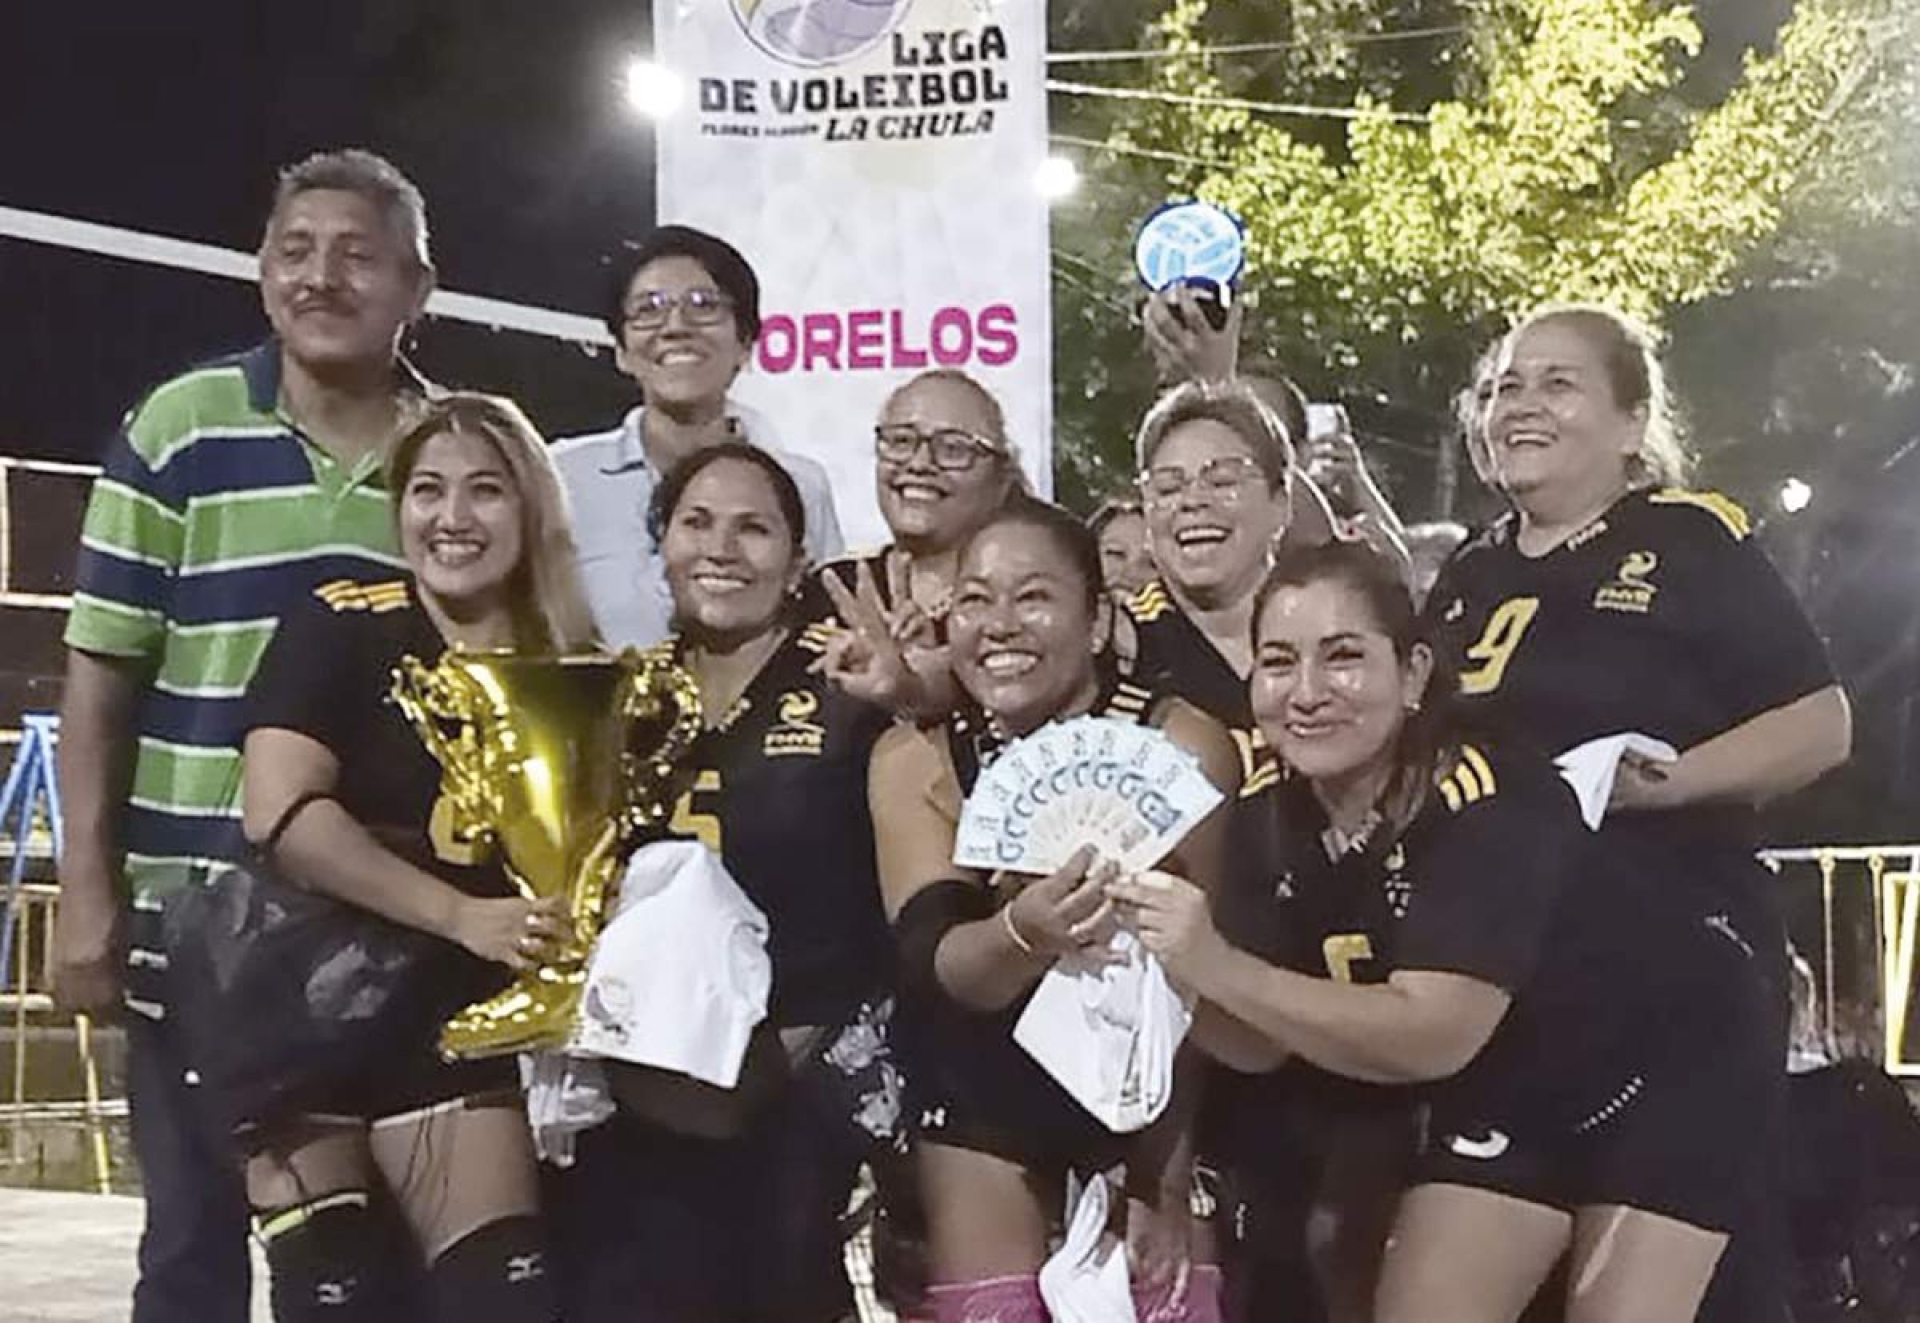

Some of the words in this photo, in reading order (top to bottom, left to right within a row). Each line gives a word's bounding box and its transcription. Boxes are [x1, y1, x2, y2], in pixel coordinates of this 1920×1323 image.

[892, 26, 1008, 67] LIGA
[699, 78, 758, 114] DE
[770, 68, 1009, 113] VOLEIBOL
[824, 117, 869, 142] LA
[876, 110, 995, 140] CHULA
[758, 303, 1019, 374] ORELOS
[1459, 597, 1539, 693] 9
